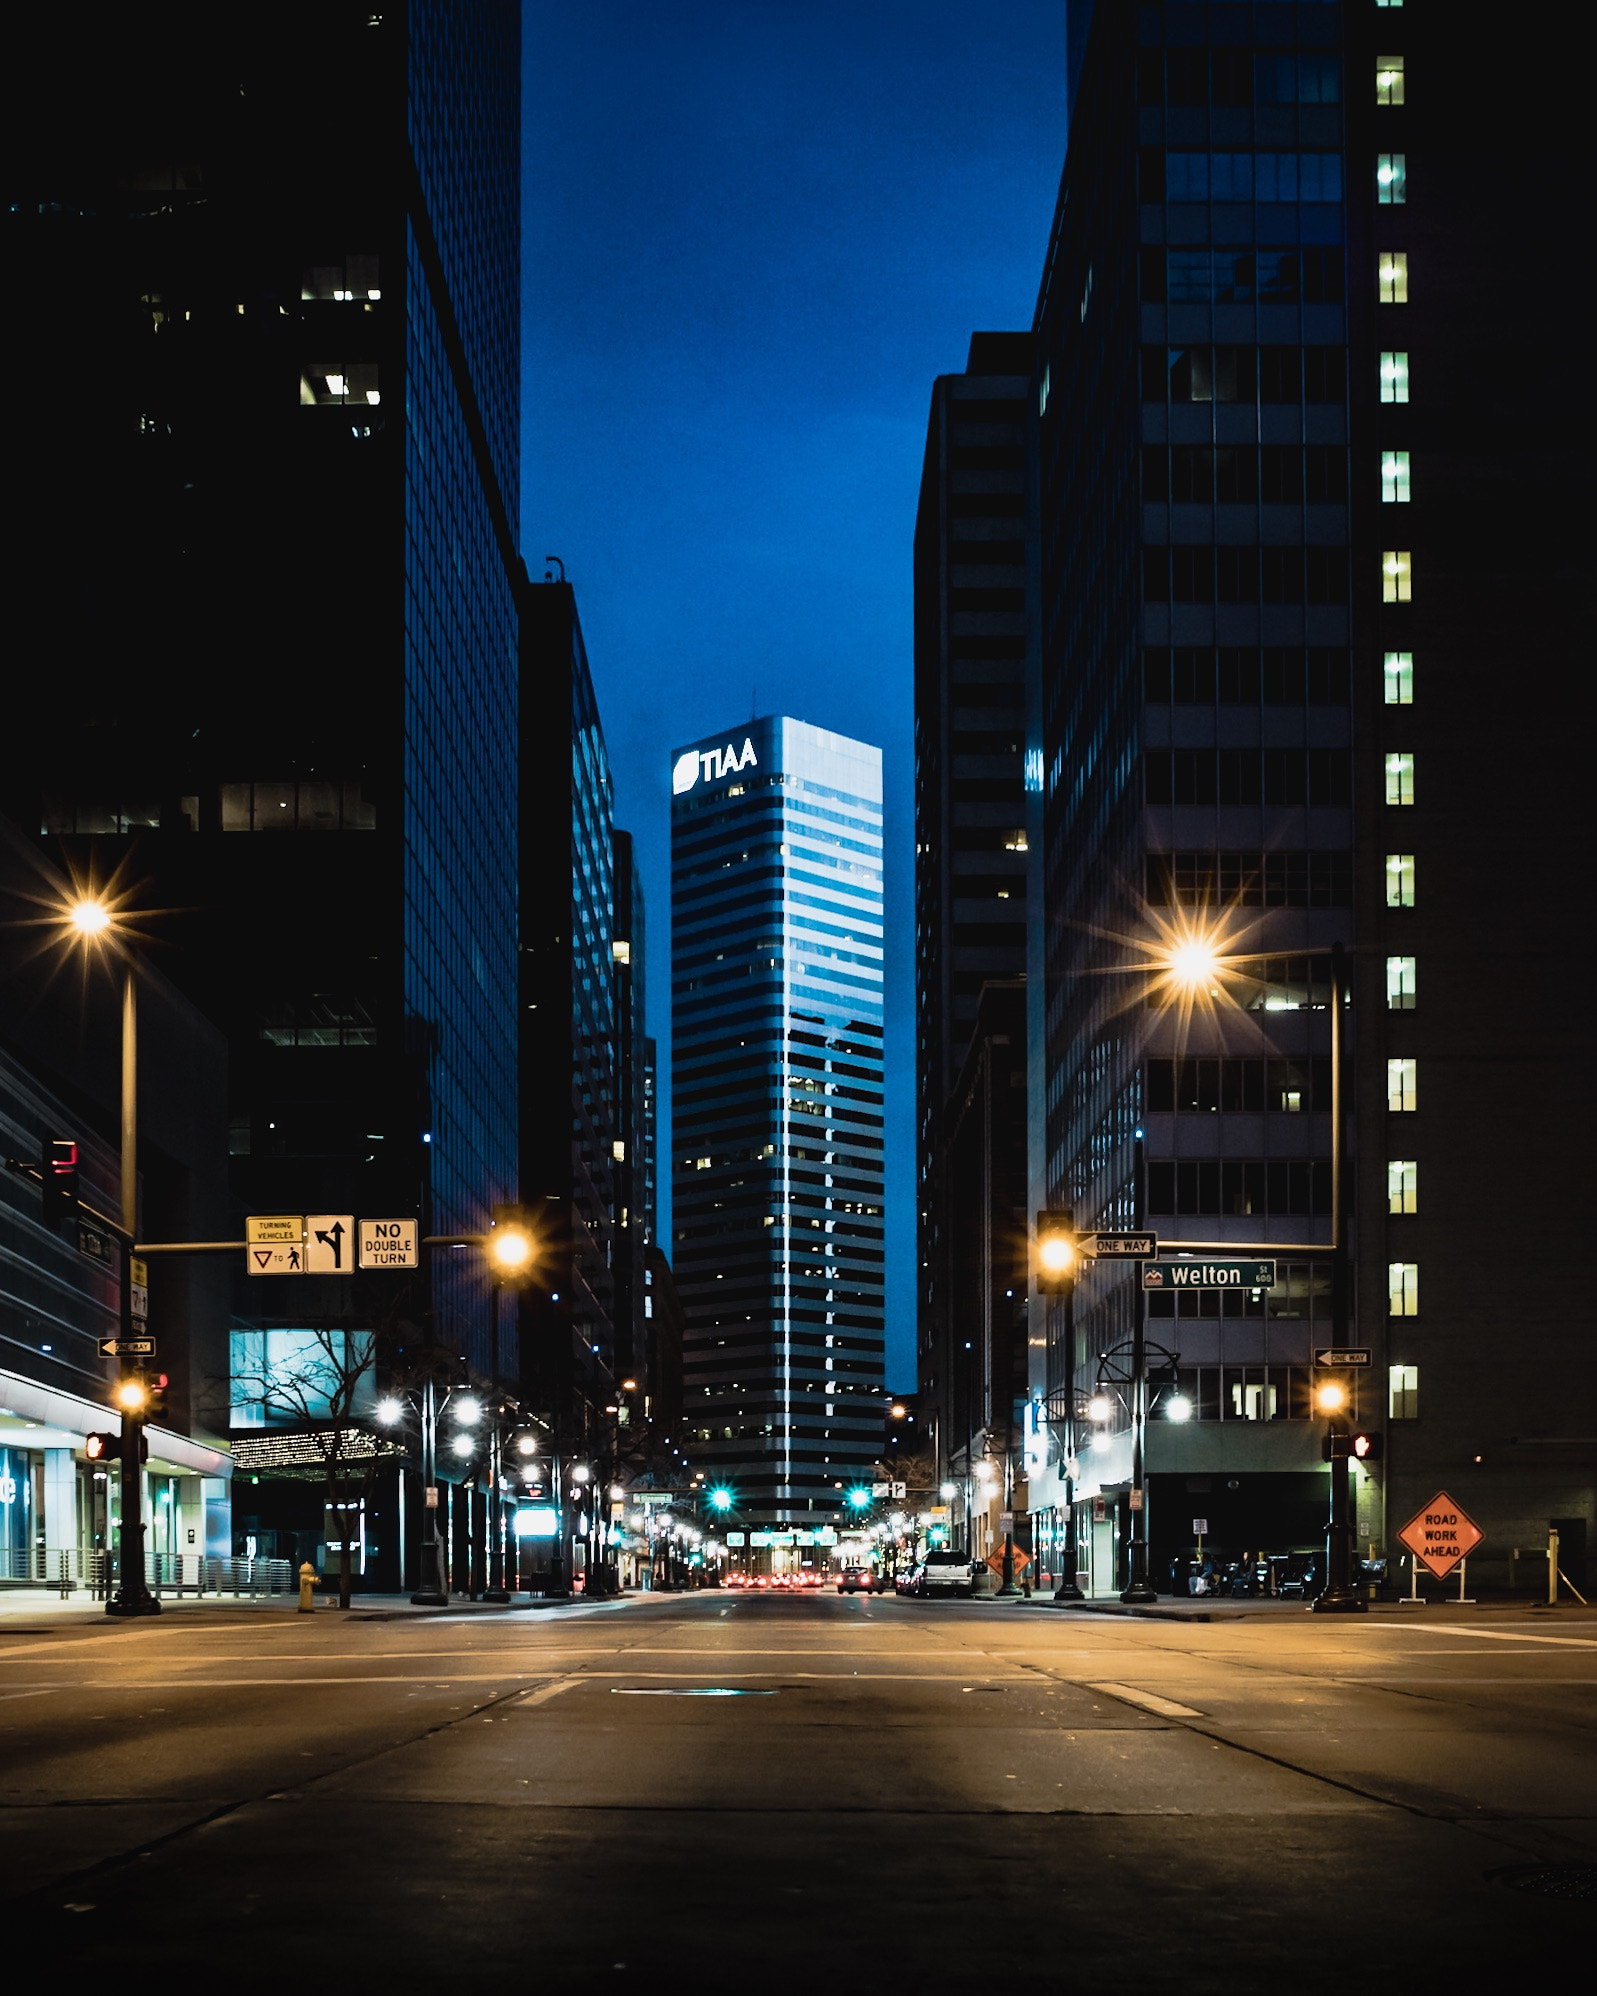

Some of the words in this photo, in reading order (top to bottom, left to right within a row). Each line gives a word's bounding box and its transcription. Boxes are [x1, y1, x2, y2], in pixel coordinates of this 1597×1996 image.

[699, 737, 758, 782] TIAA
[259, 1221, 292, 1230] TURNING
[375, 1223, 401, 1238] NO
[257, 1231, 294, 1240] VEHICLES
[365, 1240, 412, 1252] DOUBLE
[1097, 1240, 1119, 1252] ONE
[1123, 1240, 1148, 1252] WAY
[373, 1253, 407, 1264] TURN
[1171, 1265, 1241, 1285] Welton
[1259, 1264, 1268, 1274] St
[1255, 1274, 1272, 1283] 600
[116, 1343, 130, 1351] ONE
[1331, 1354, 1347, 1362] ONE
[1348, 1354, 1366, 1362] WAY
[1425, 1514, 1458, 1525] ROAD
[1425, 1530, 1458, 1541] WORK
[1423, 1546, 1460, 1557] AHEAD
